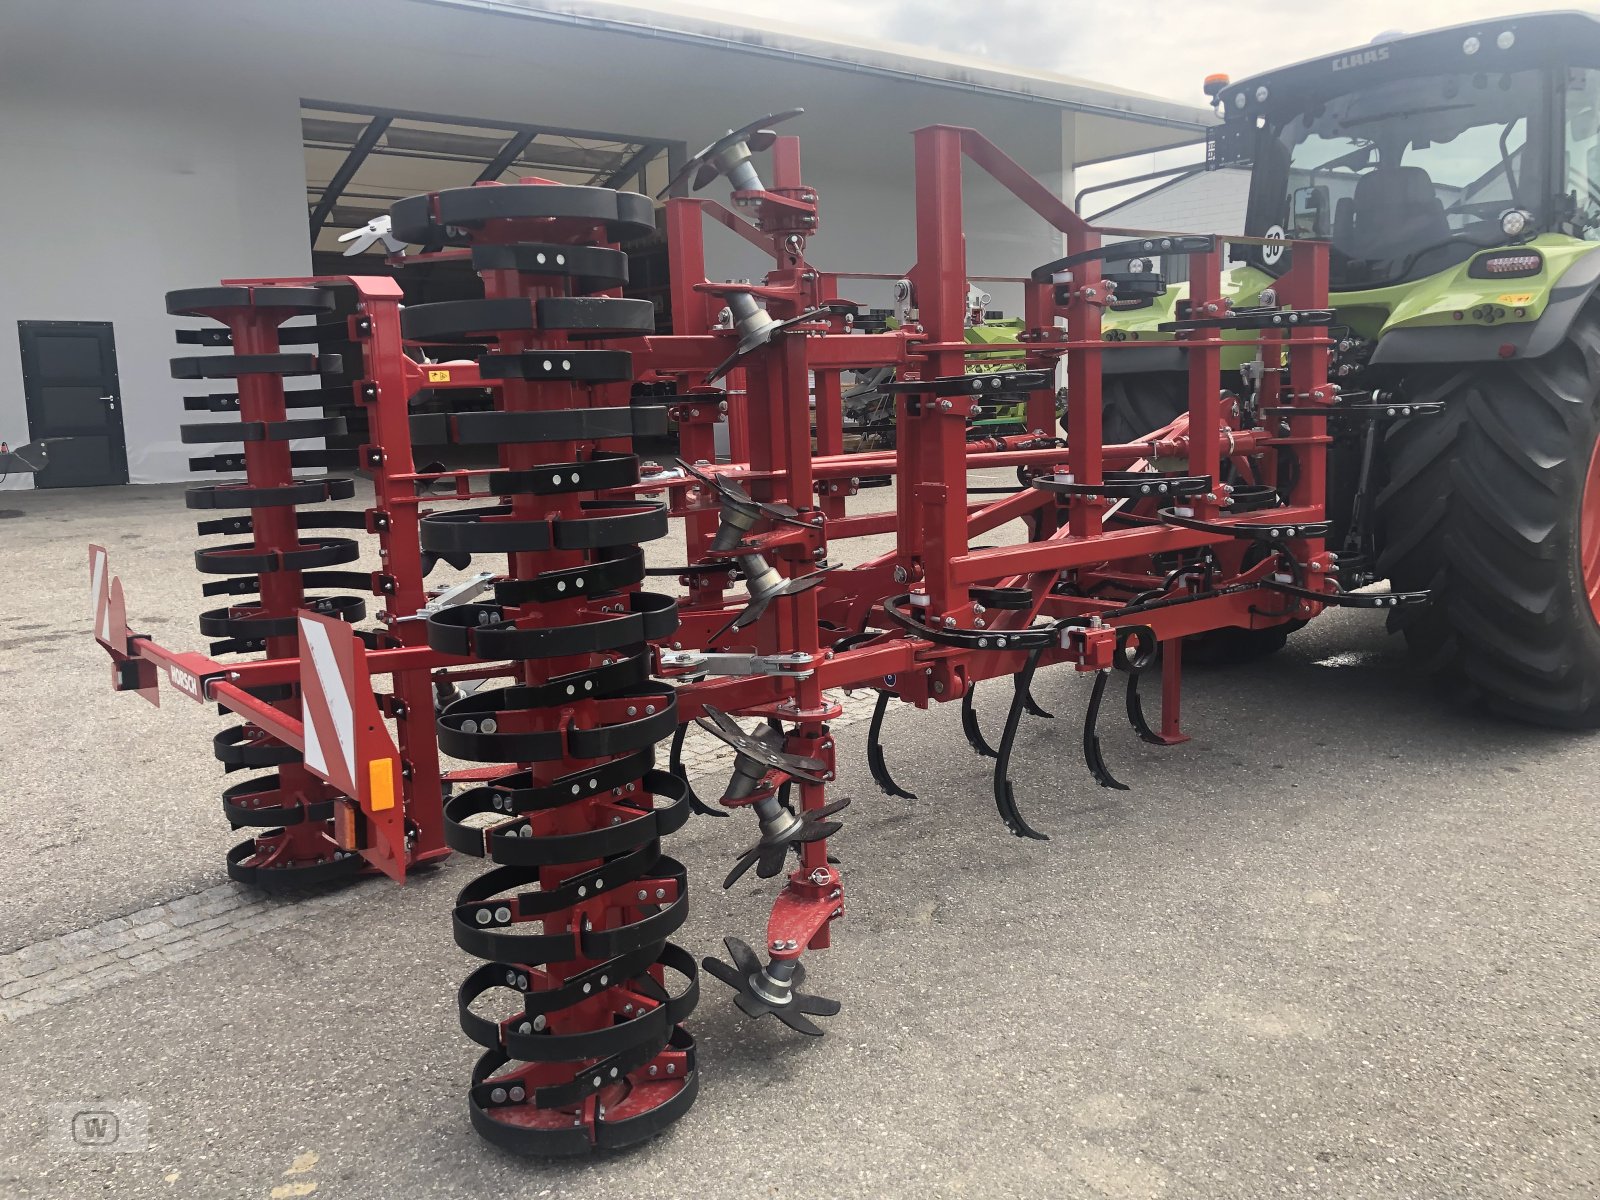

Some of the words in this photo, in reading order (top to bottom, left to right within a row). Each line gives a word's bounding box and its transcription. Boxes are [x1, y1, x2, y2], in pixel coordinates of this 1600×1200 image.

[1332, 47, 1390, 71] CLAAS
[1266, 232, 1280, 258] 50
[170, 664, 198, 696] HORSCH
